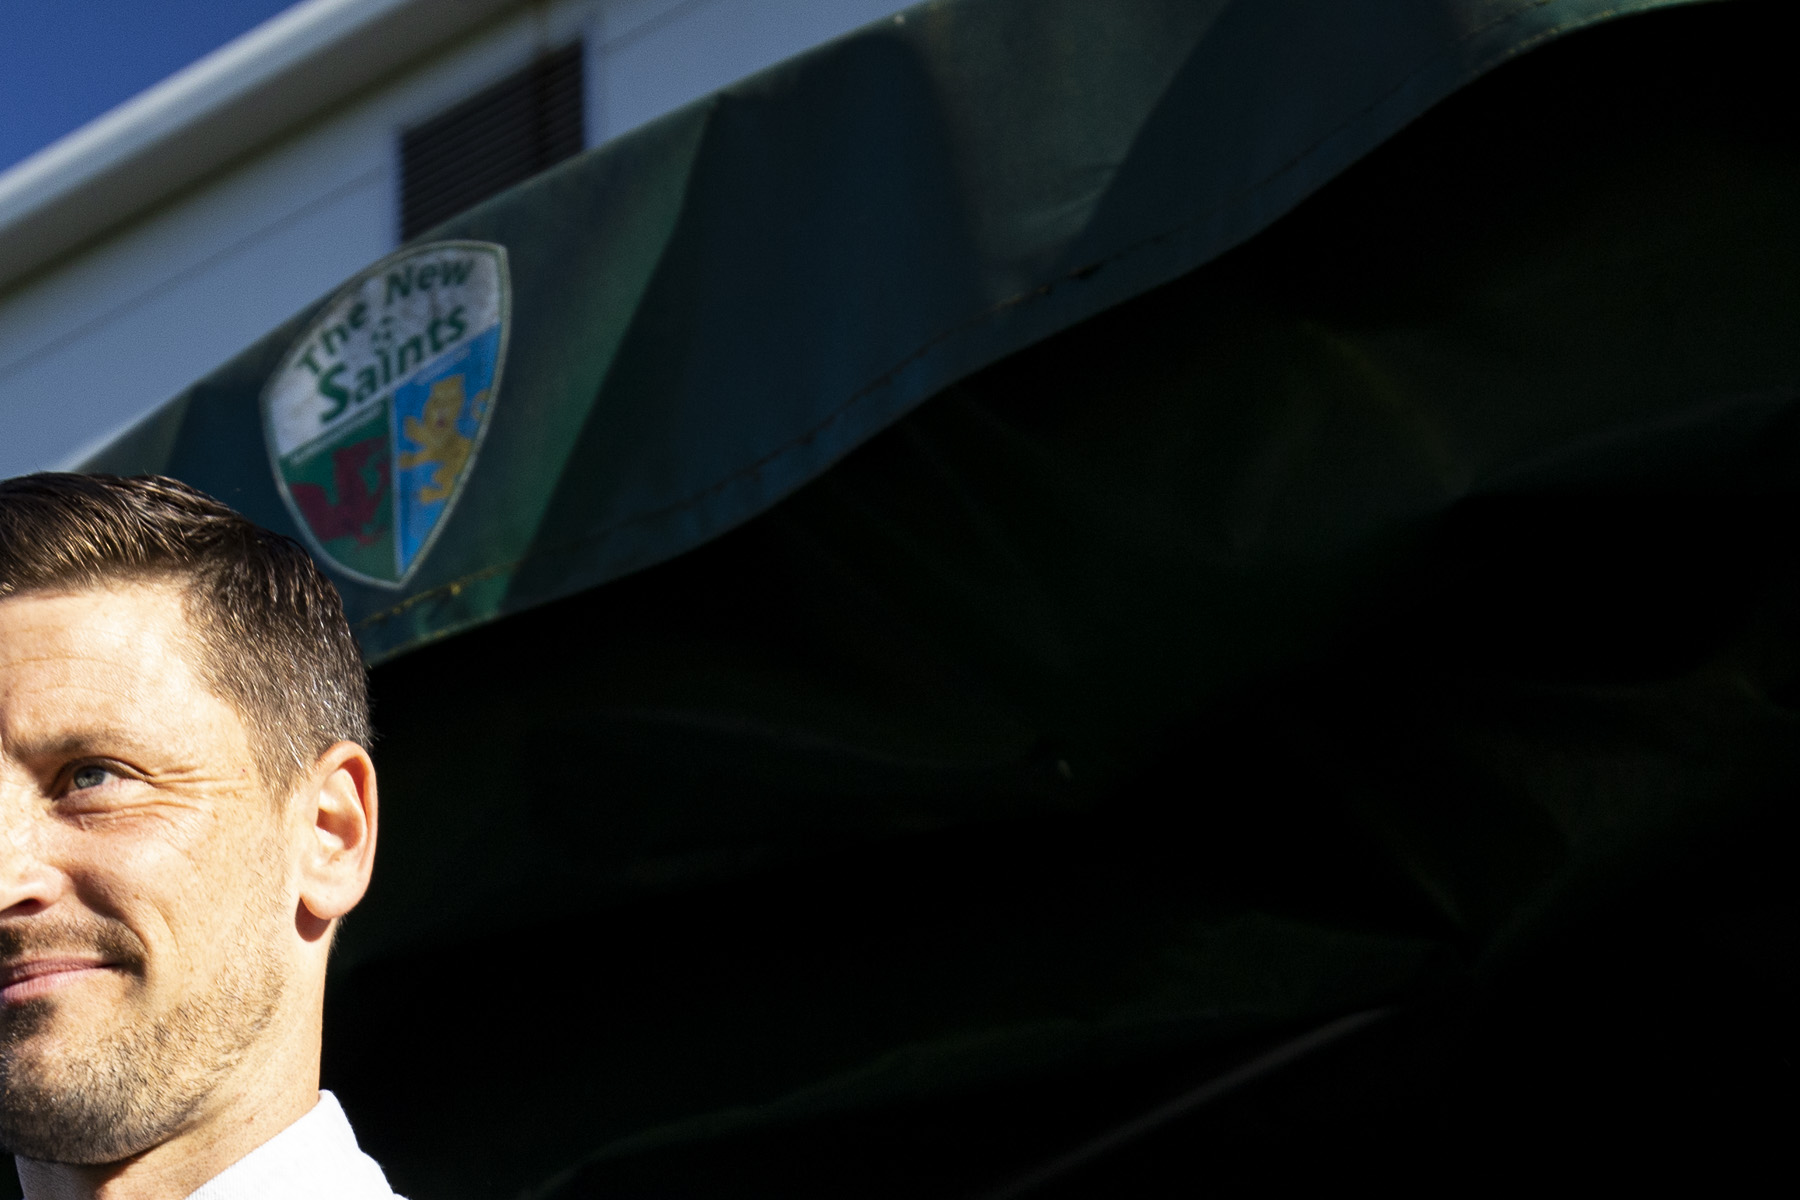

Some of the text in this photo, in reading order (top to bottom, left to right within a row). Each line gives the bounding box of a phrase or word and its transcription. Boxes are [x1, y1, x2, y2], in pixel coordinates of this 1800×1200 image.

[295, 301, 369, 375] The
[385, 258, 475, 305] New
[318, 306, 468, 423] Saints
